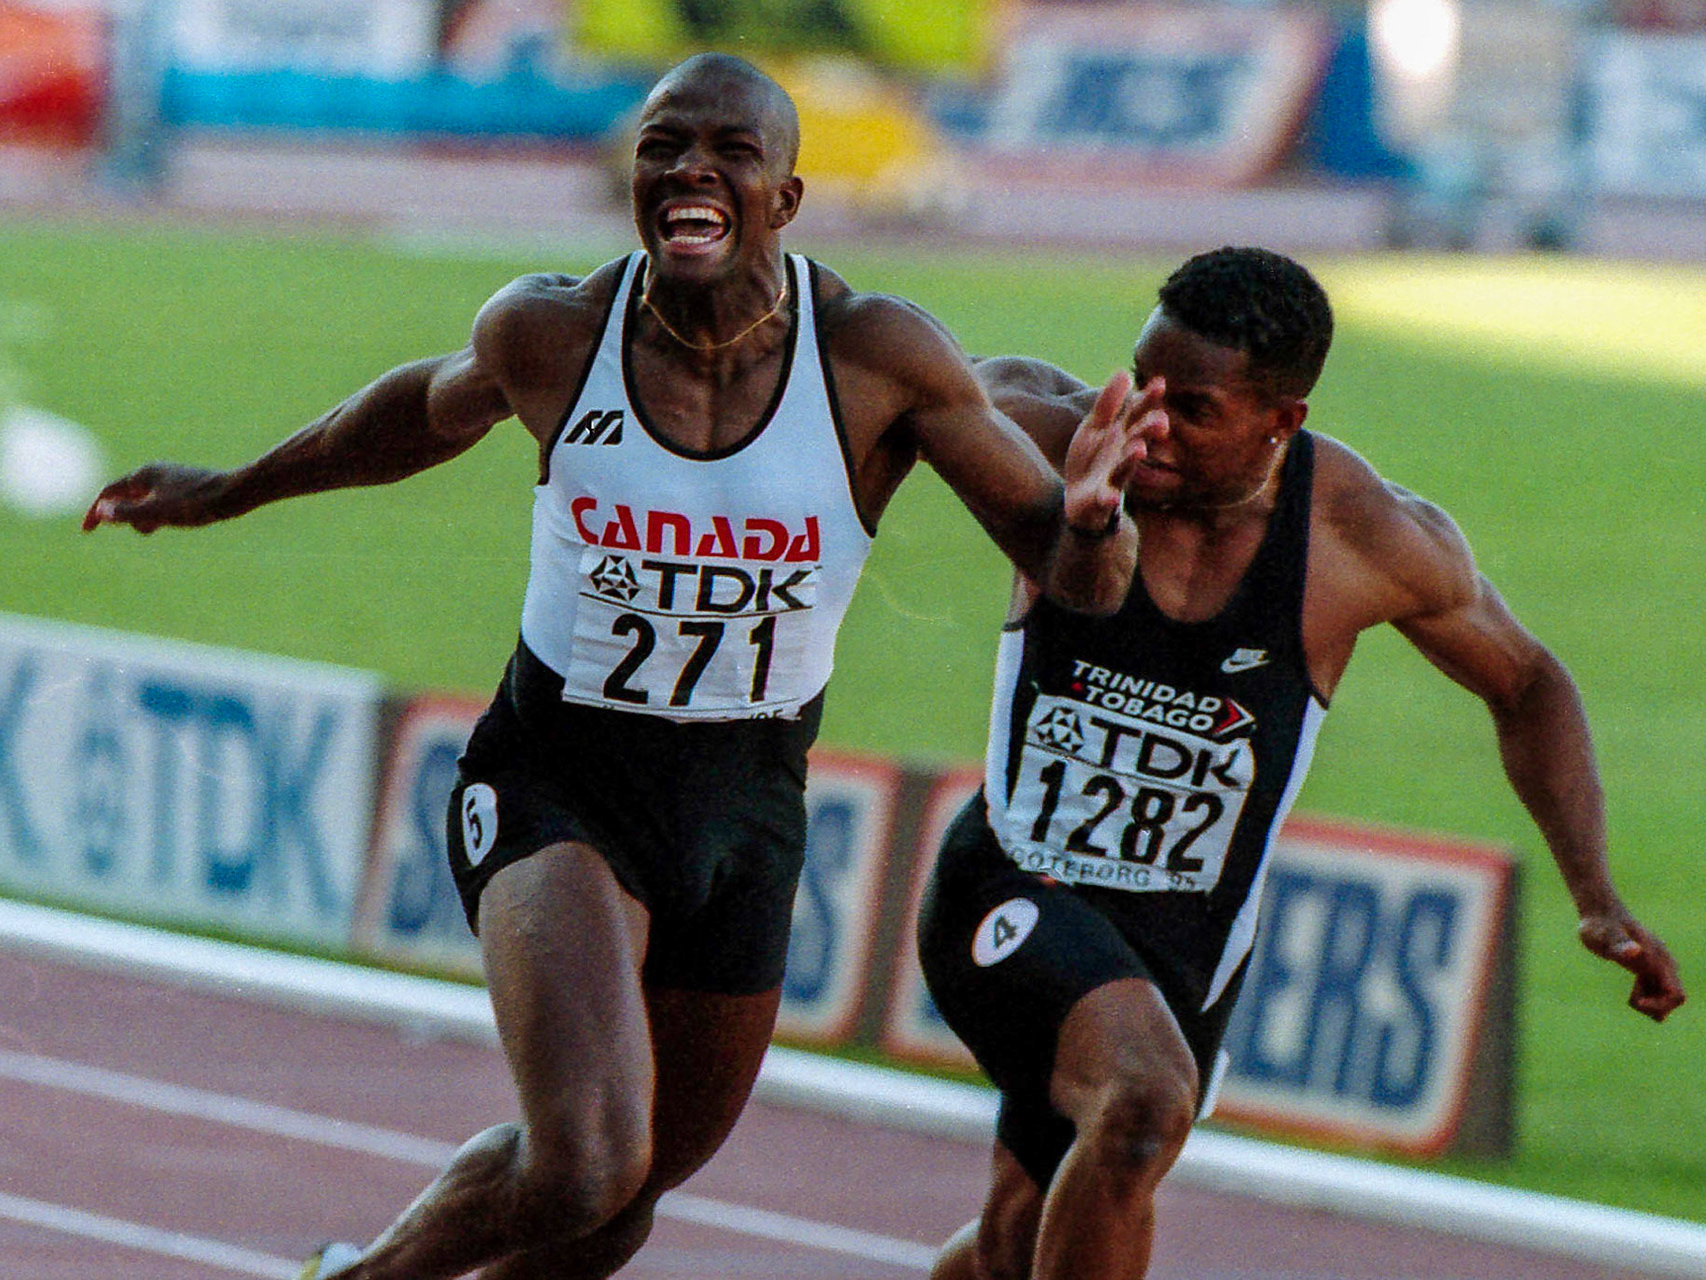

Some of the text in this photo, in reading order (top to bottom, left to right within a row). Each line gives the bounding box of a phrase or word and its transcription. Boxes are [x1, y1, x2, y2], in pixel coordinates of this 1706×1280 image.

[571, 496, 820, 563] CANADA
[641, 559, 817, 612] TDK
[603, 613, 777, 707] 271
[1072, 659, 1221, 713] TRINIDAD
[1086, 685, 1214, 731] TOBAGO
[1089, 717, 1241, 787] TDK
[1031, 760, 1225, 872] 1282
[993, 914, 1018, 949] 4
